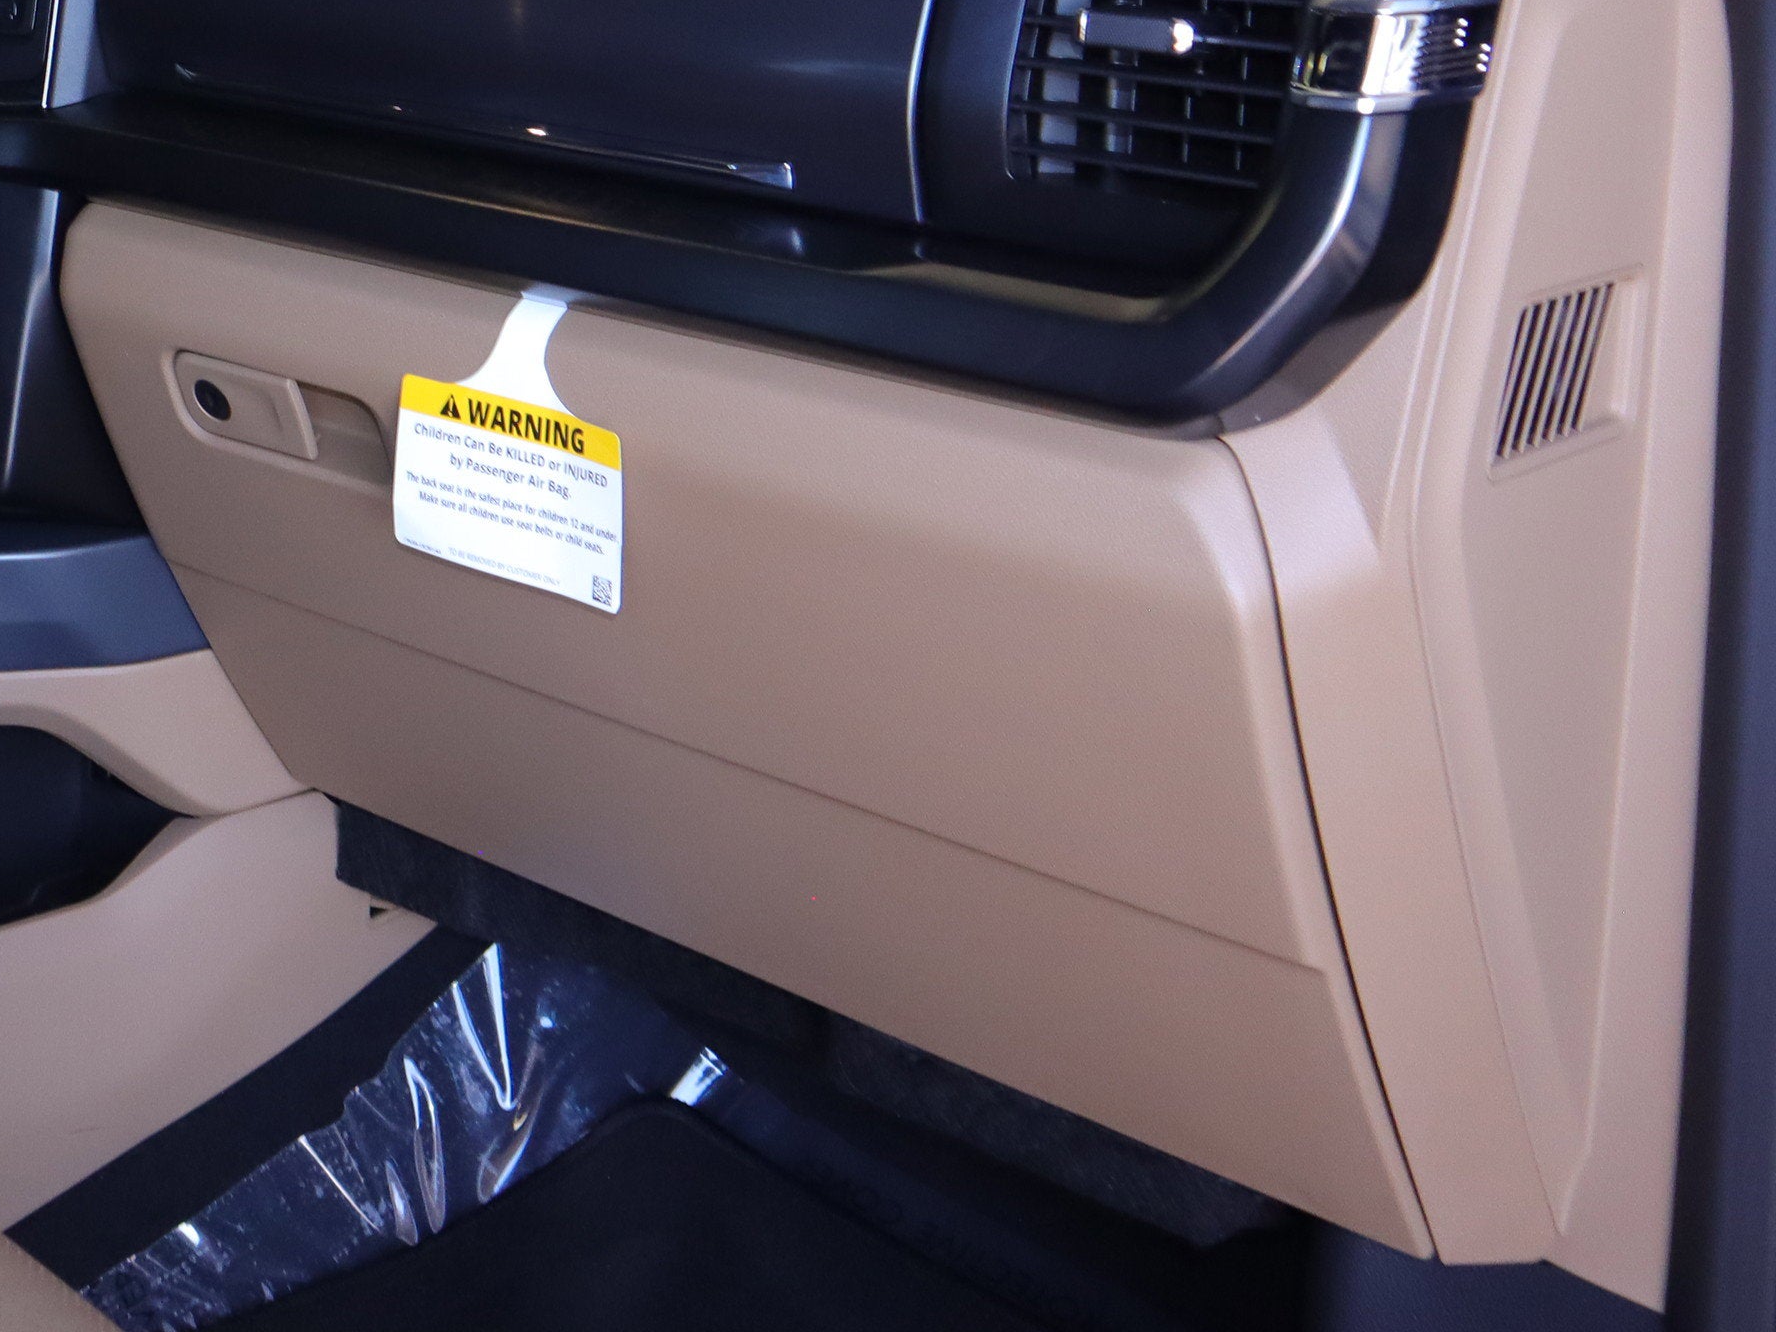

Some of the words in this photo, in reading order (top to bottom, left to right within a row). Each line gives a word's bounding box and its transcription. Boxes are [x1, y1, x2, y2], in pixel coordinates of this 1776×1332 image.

[413, 421, 461, 445] Children
[464, 435, 485, 451] Can
[488, 442, 503, 456] Be
[506, 446, 545, 467] KILLED
[549, 459, 561, 471] or
[564, 461, 608, 488] INJURED
[467, 397, 585, 455] WARNING
[406, 470, 419, 484] The
[421, 474, 437, 489] back
[439, 481, 455, 494] seat
[456, 485, 463, 496] is
[464, 488, 477, 499] the
[478, 492, 501, 507] safest
[502, 498, 523, 513] place
[525, 504, 536, 516] for
[538, 509, 569, 526] children
[571, 517, 579, 530] 12
[580, 521, 595, 536] and
[450, 452, 464, 470] by
[466, 456, 525, 484] Passenger
[528, 474, 546, 489] Air
[548, 479, 572, 500] Bag.
[419, 490, 439, 505] Make
[440, 498, 457, 511] sure
[458, 502, 468, 513] all
[469, 505, 500, 523] children
[501, 515, 514, 527] use
[516, 518, 533, 532] seat
[534, 523, 554, 538] belts
[555, 530, 564, 541] or
[565, 533, 583, 548] child
[467, 552, 497, 568] REMOVED
[506, 565, 542, 581] CUSTOMER
[543, 574, 561, 587] ONLY
